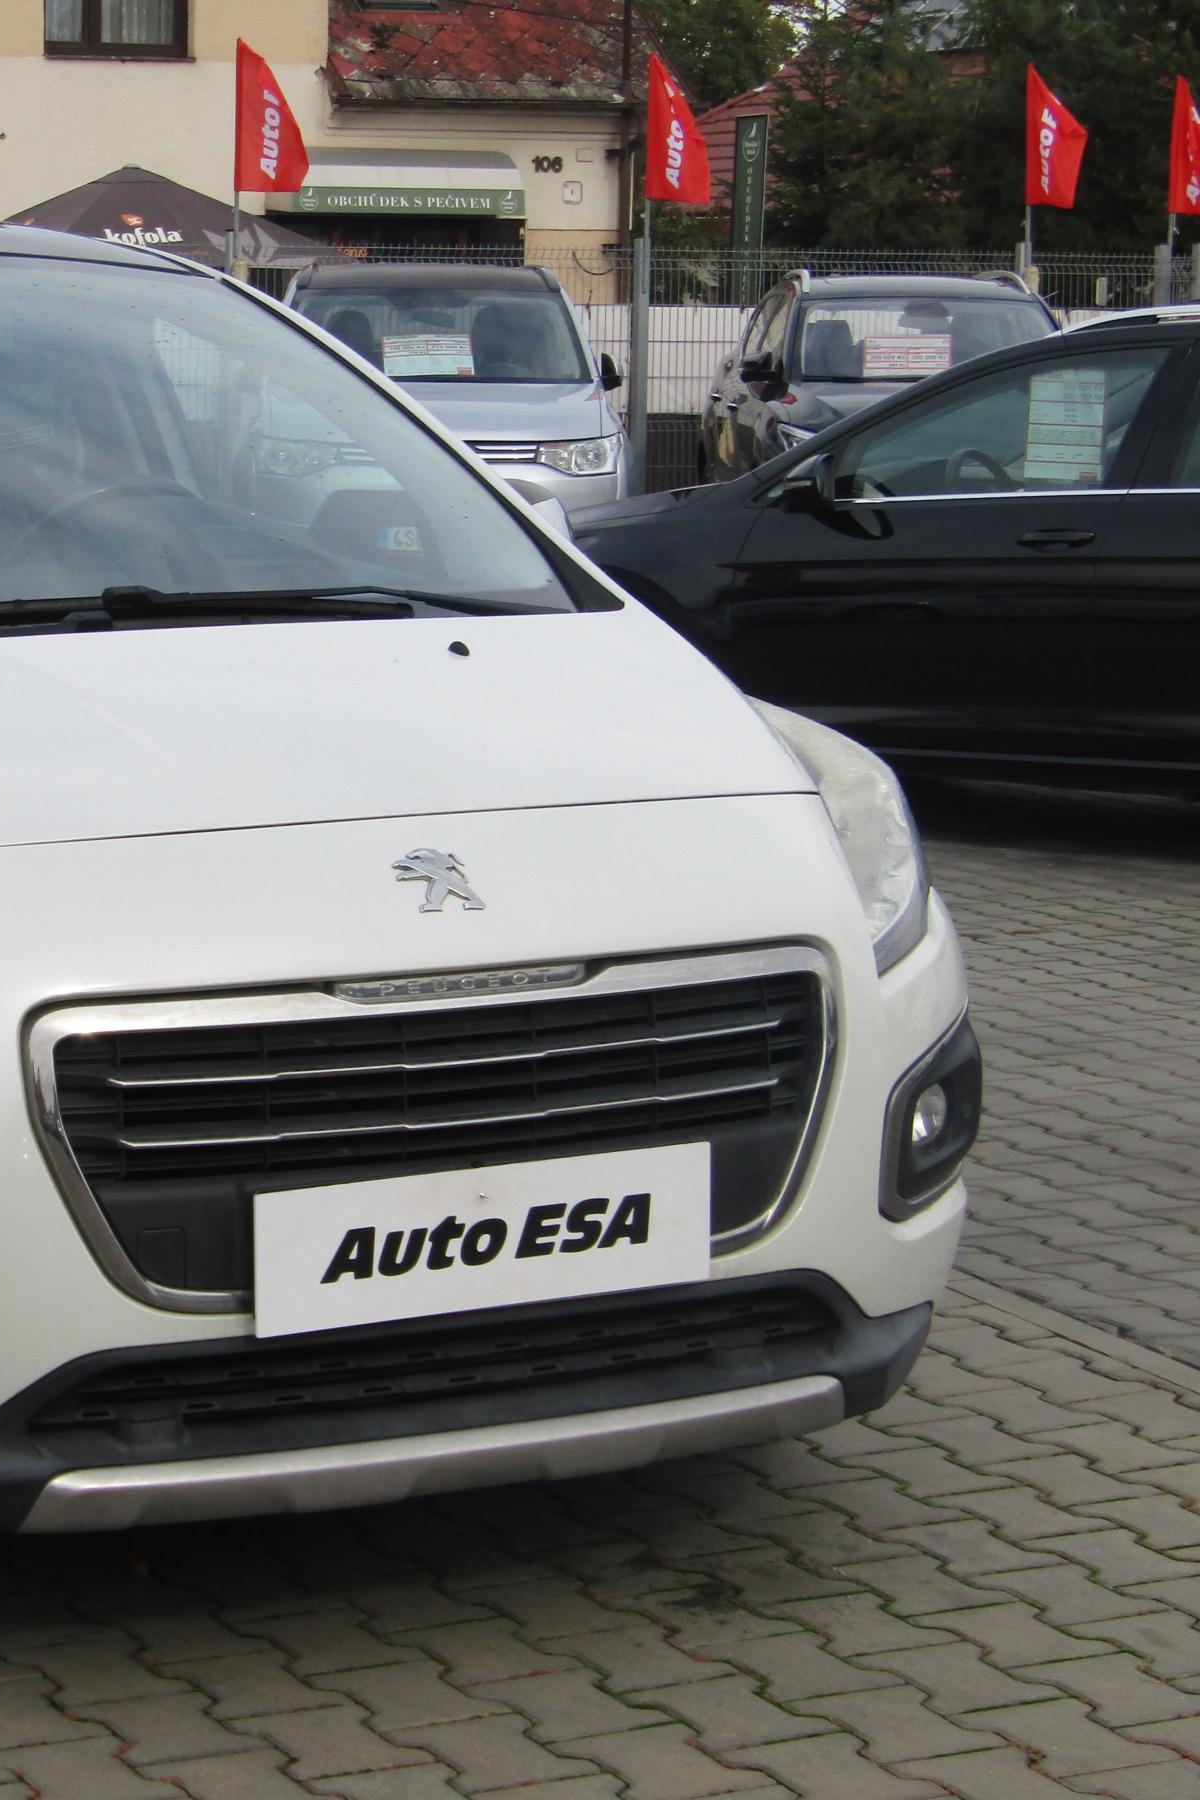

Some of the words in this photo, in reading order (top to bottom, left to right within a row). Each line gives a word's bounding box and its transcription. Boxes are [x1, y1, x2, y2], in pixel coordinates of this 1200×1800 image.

[260, 107, 280, 180] Auto
[665, 120, 684, 189] Auto
[532, 155, 563, 173] 106
[414, 195, 423, 208] S
[427, 194, 490, 209] PEČIVEM
[103, 227, 183, 246] kofola
[379, 968, 552, 996] PEUGEOT
[320, 1215, 508, 1285] Auto
[514, 1192, 652, 1260] ESA
